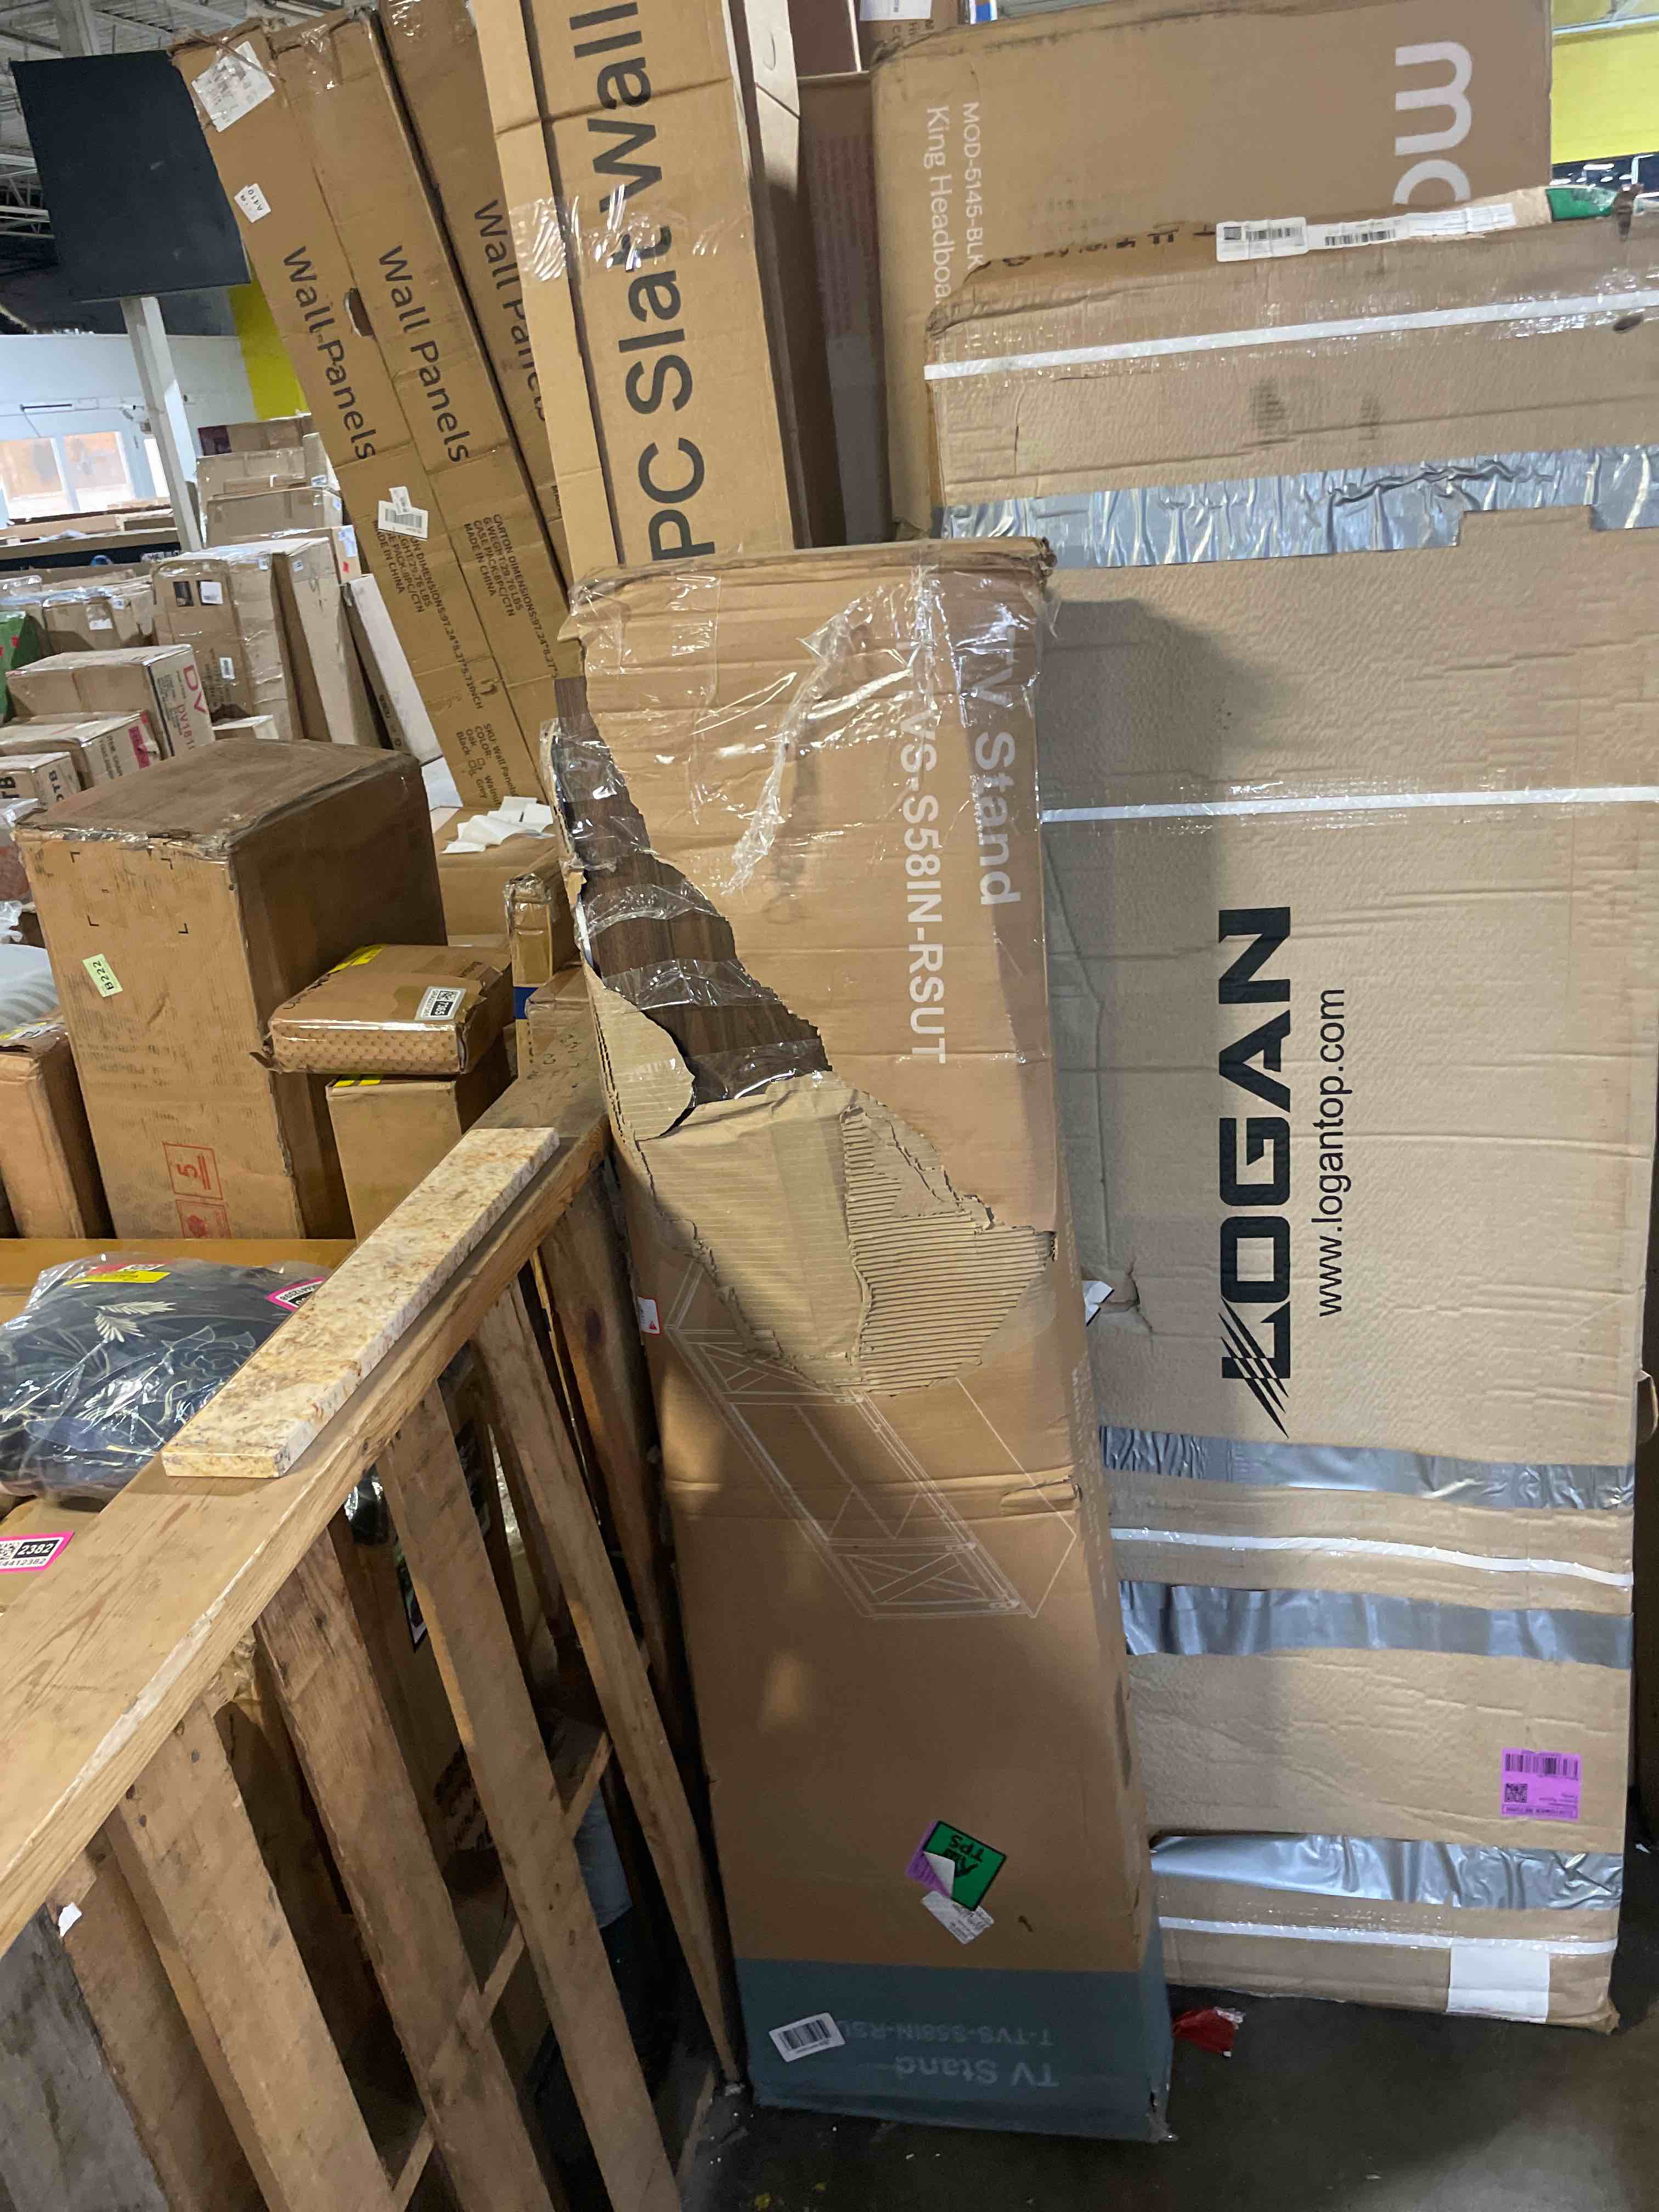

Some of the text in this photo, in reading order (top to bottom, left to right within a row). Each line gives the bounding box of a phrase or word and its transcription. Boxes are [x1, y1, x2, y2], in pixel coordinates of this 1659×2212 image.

[569, 2, 662, 213] Wall
[924, 106, 956, 306] King Headboa
[475, 200, 520, 290] Wall
[611, 226, 693, 414] Slat
[284, 245, 377, 460] Wall Panels
[379, 245, 470, 462] Wall Panels
[474, 520, 489, 545] CASE
[493, 514, 514, 554] CARTON
[383, 549, 392, 561] IN
[388, 563, 405, 594] CHINA
[464, 523, 496, 596] MADE IN CHINA
[511, 592, 524, 610] LBS
[456, 731, 471, 756] Black
[466, 729, 477, 746] Oak
[475, 726, 492, 759] COLOR:
[493, 747, 506, 765] Wall
[975, 731, 1021, 905] Stand
[93, 961, 115, 991] B222
[1219, 907, 1290, 1388] LOGAN
[1312, 989, 1353, 1316] www.logantop.com
[0, 1558, 46, 1567] 4412382
[18, 1543, 54, 1555] 2382
[895, 2055, 1059, 2087] TV Stand
